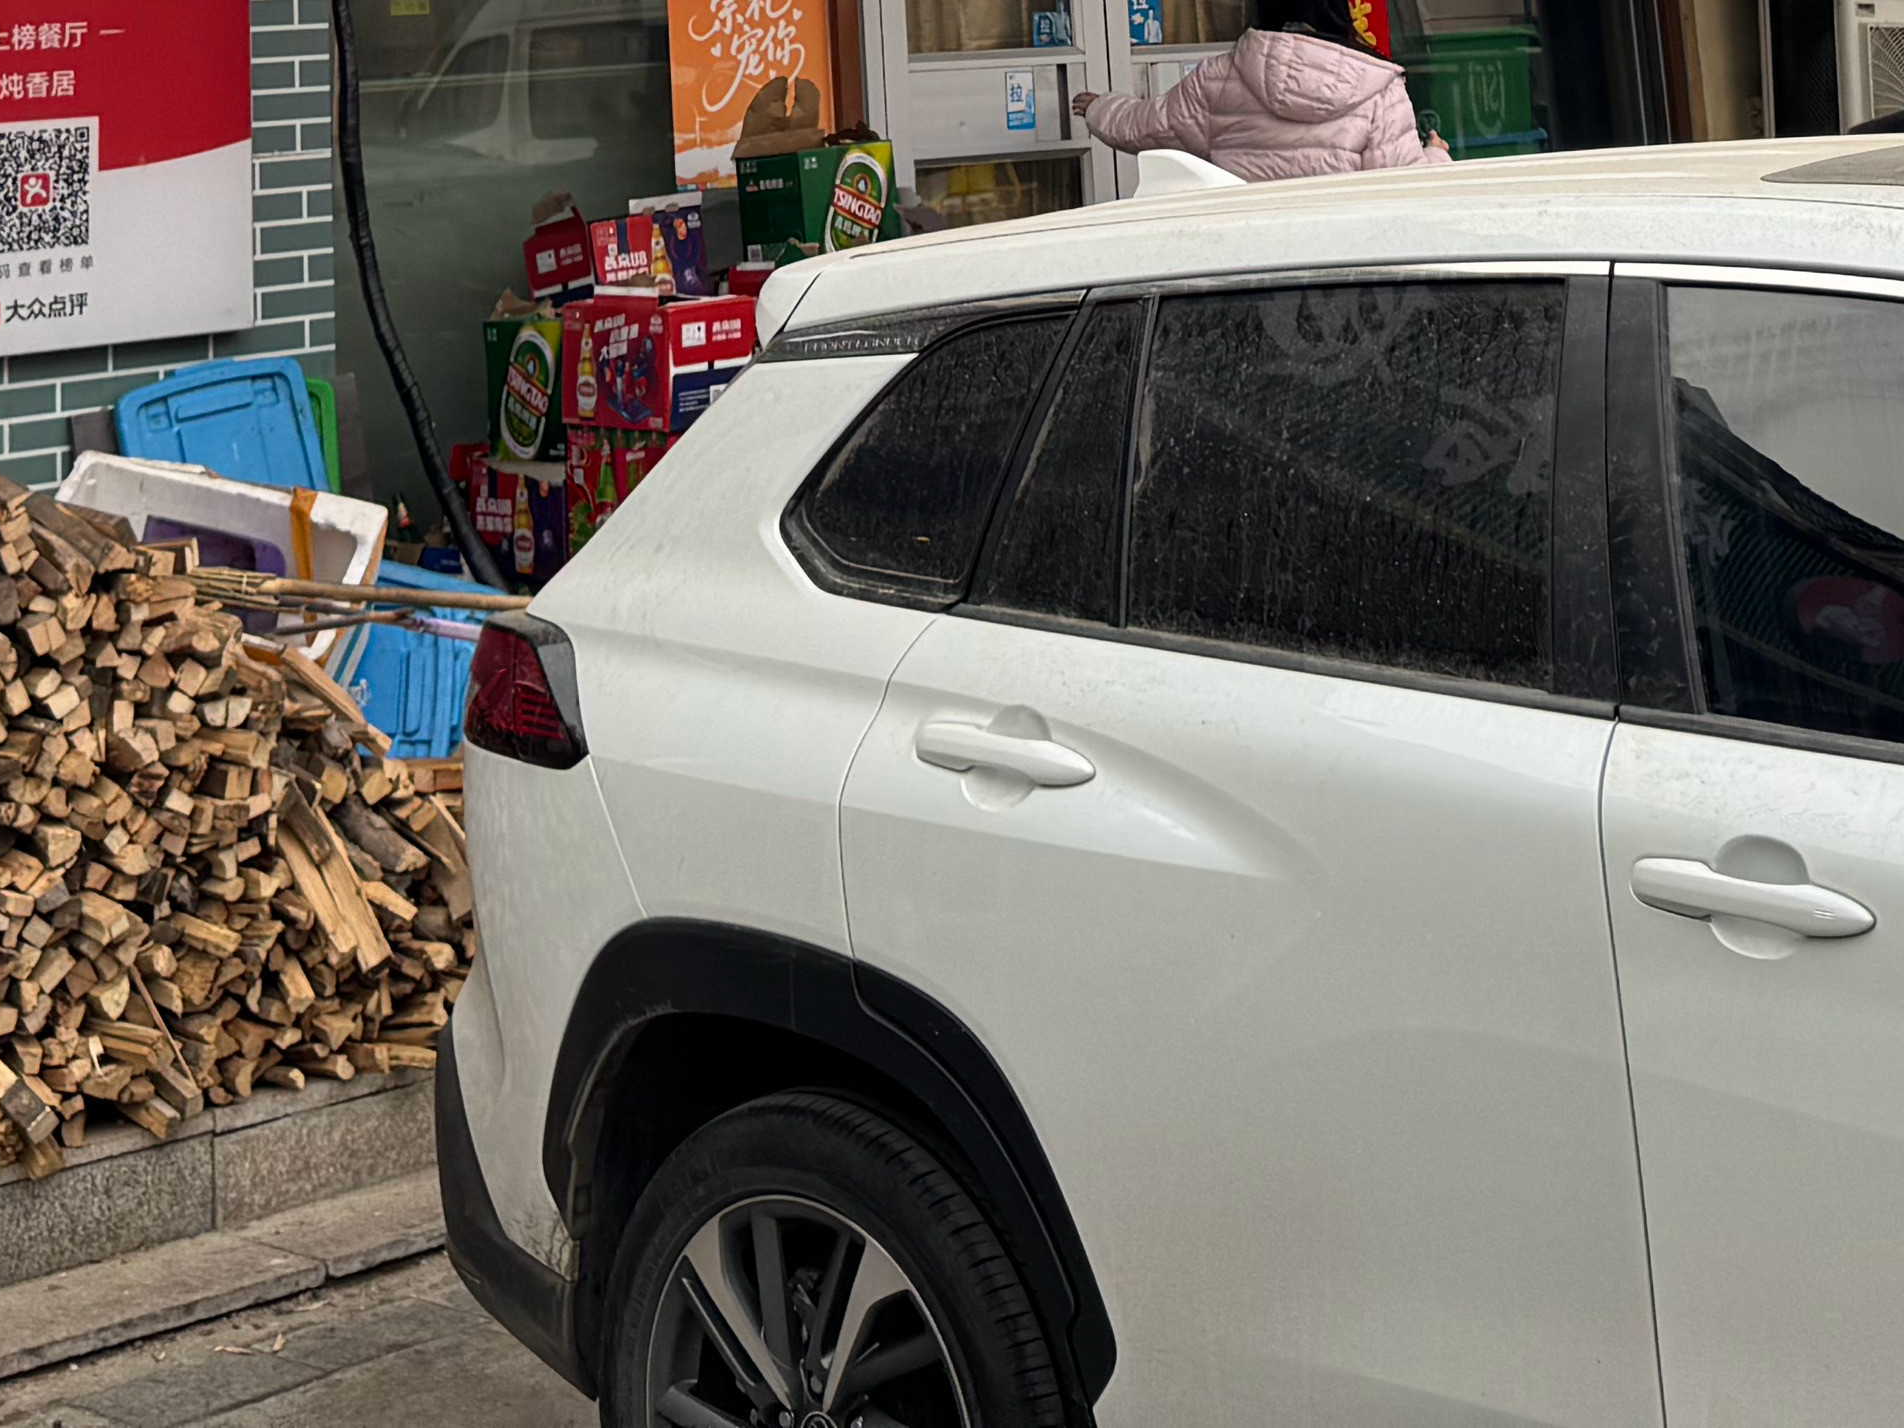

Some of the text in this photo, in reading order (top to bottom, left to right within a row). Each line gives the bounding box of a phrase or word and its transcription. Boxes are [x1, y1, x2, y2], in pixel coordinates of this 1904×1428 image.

[1009, 83, 1024, 103] 拉
[834, 188, 882, 226] TSINGTAO
[5, 292, 89, 323] 大众点评
[507, 366, 549, 415] TSINGTAO
